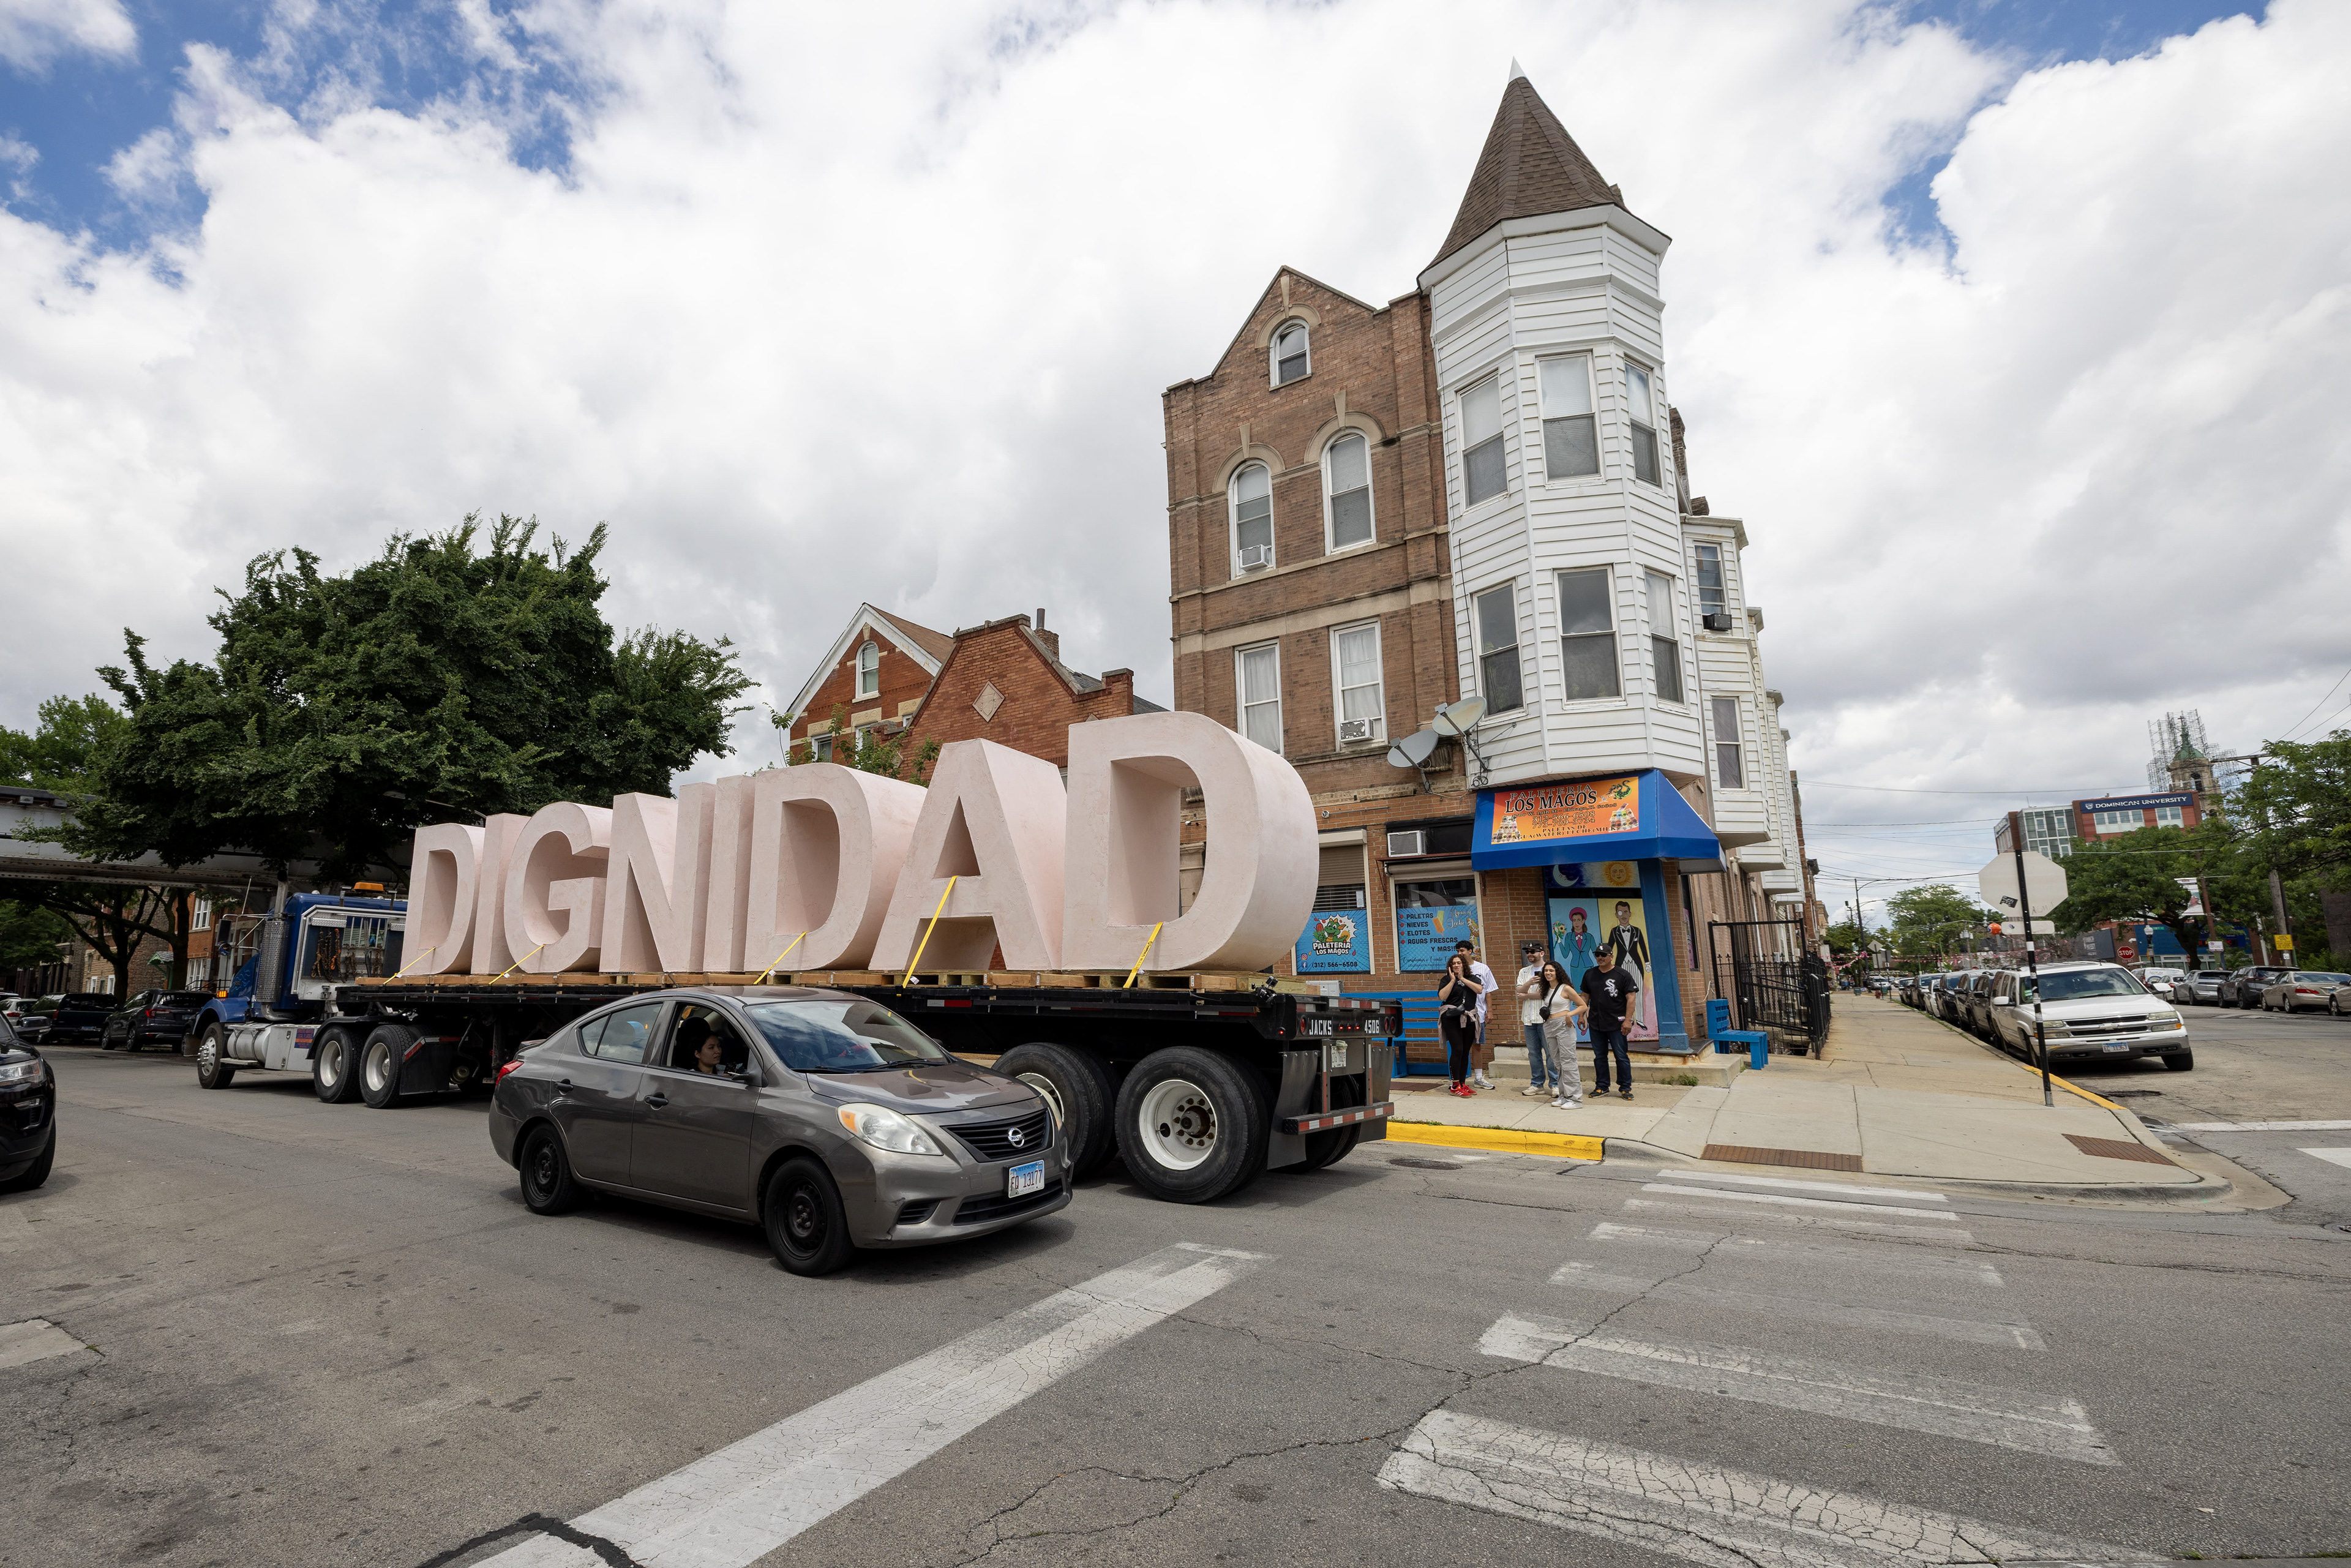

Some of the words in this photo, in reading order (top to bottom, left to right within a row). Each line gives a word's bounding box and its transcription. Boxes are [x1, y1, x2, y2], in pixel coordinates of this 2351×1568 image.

[1510, 784, 1592, 800] PALETERIA
[1504, 797, 1535, 814] LOS
[1539, 790, 1597, 809] MAGOS
[2095, 800, 2140, 809] DOMINICAN
[2142, 797, 2187, 805] UNIVERSITY
[1532, 811, 1595, 823] 312-566-6508
[1532, 817, 1595, 829] 773-709-3734
[401, 711, 1319, 975] DIGNIDAD
[1313, 942, 1351, 950] PALETERIA
[1309, 1019, 1332, 1035] JACKS
[1364, 1019, 1379, 1034] 4506
[1011, 1175, 1019, 1191] FQ
[1023, 1169, 1042, 1188] 13177
